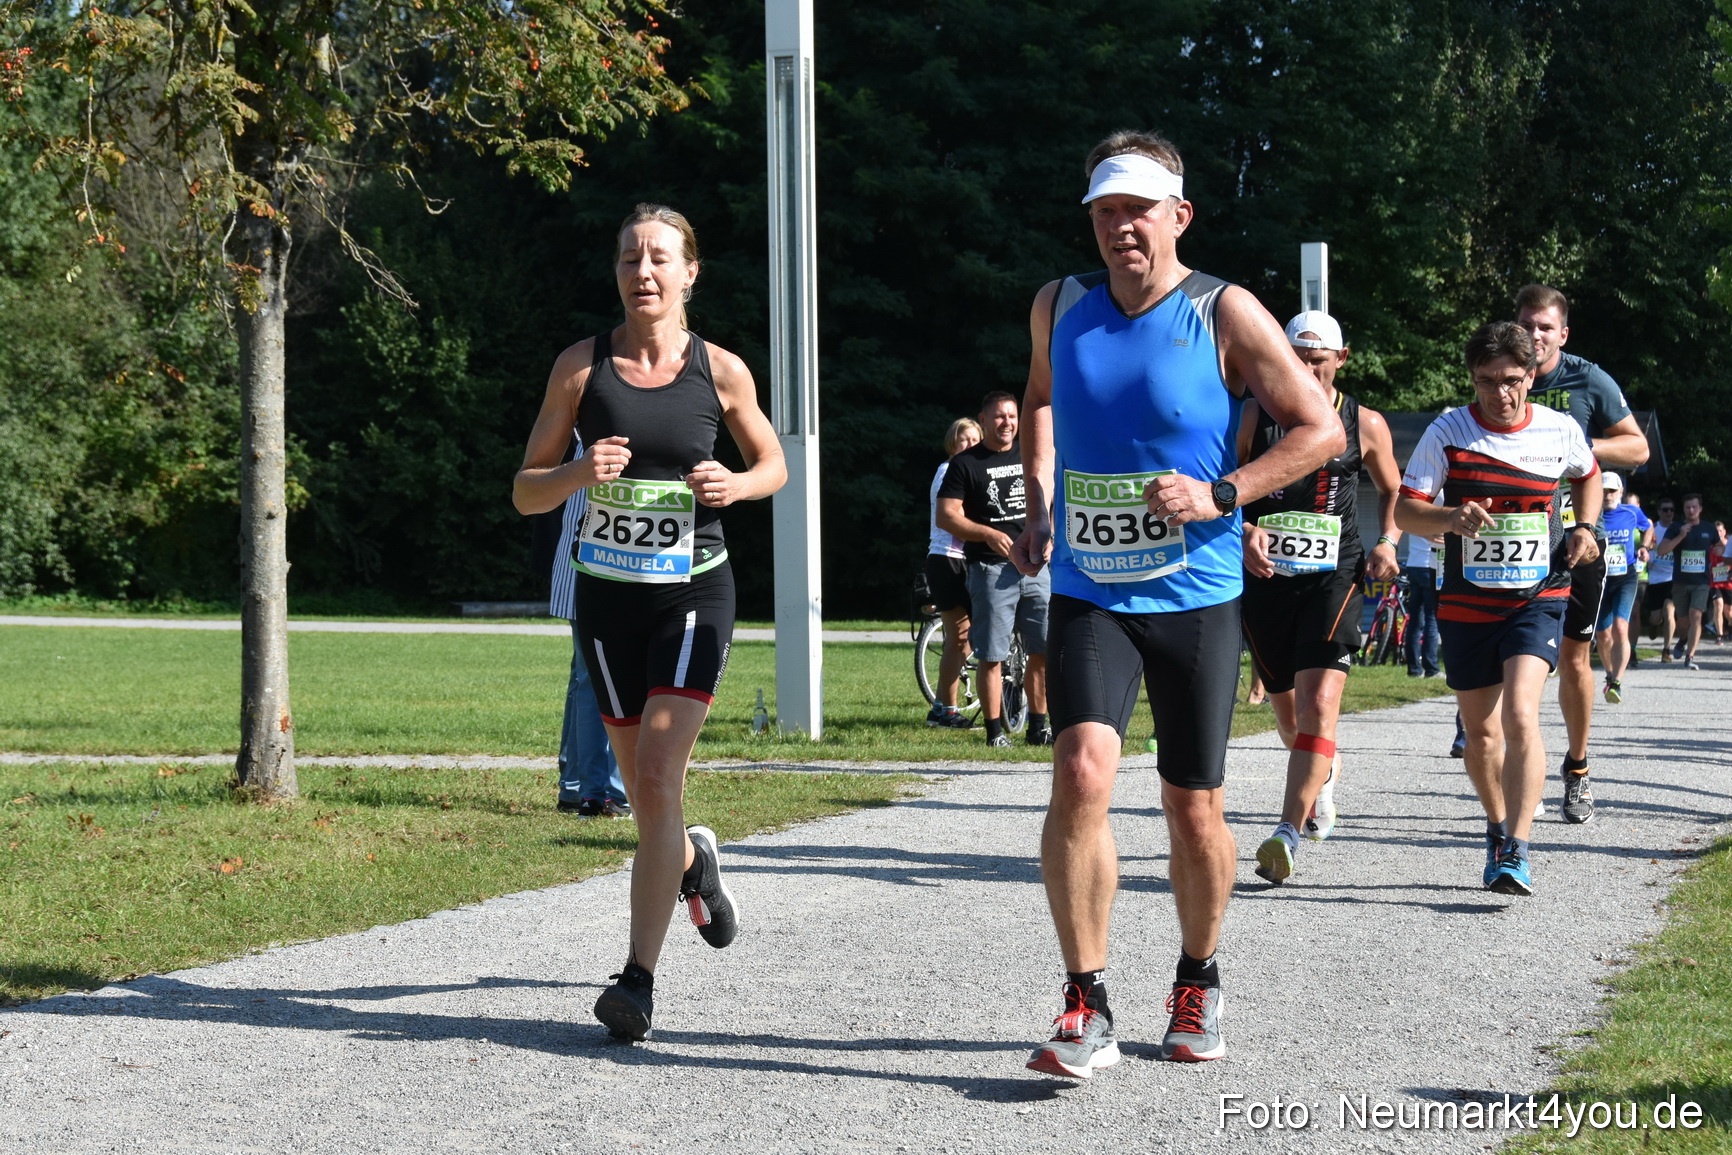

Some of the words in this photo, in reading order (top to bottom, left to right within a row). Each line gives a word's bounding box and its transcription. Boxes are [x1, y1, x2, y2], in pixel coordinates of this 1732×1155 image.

[593, 482, 685, 508] BOCK
[593, 509, 680, 548] 2629
[1075, 511, 1168, 546] 2636
[1265, 514, 1333, 533] BOCK
[1268, 533, 1328, 560] 2623
[1473, 540, 1539, 563] 2327
[593, 548, 675, 572] MANUELA
[1083, 551, 1167, 570] ANDREAS
[1475, 569, 1538, 579] GERHARD
